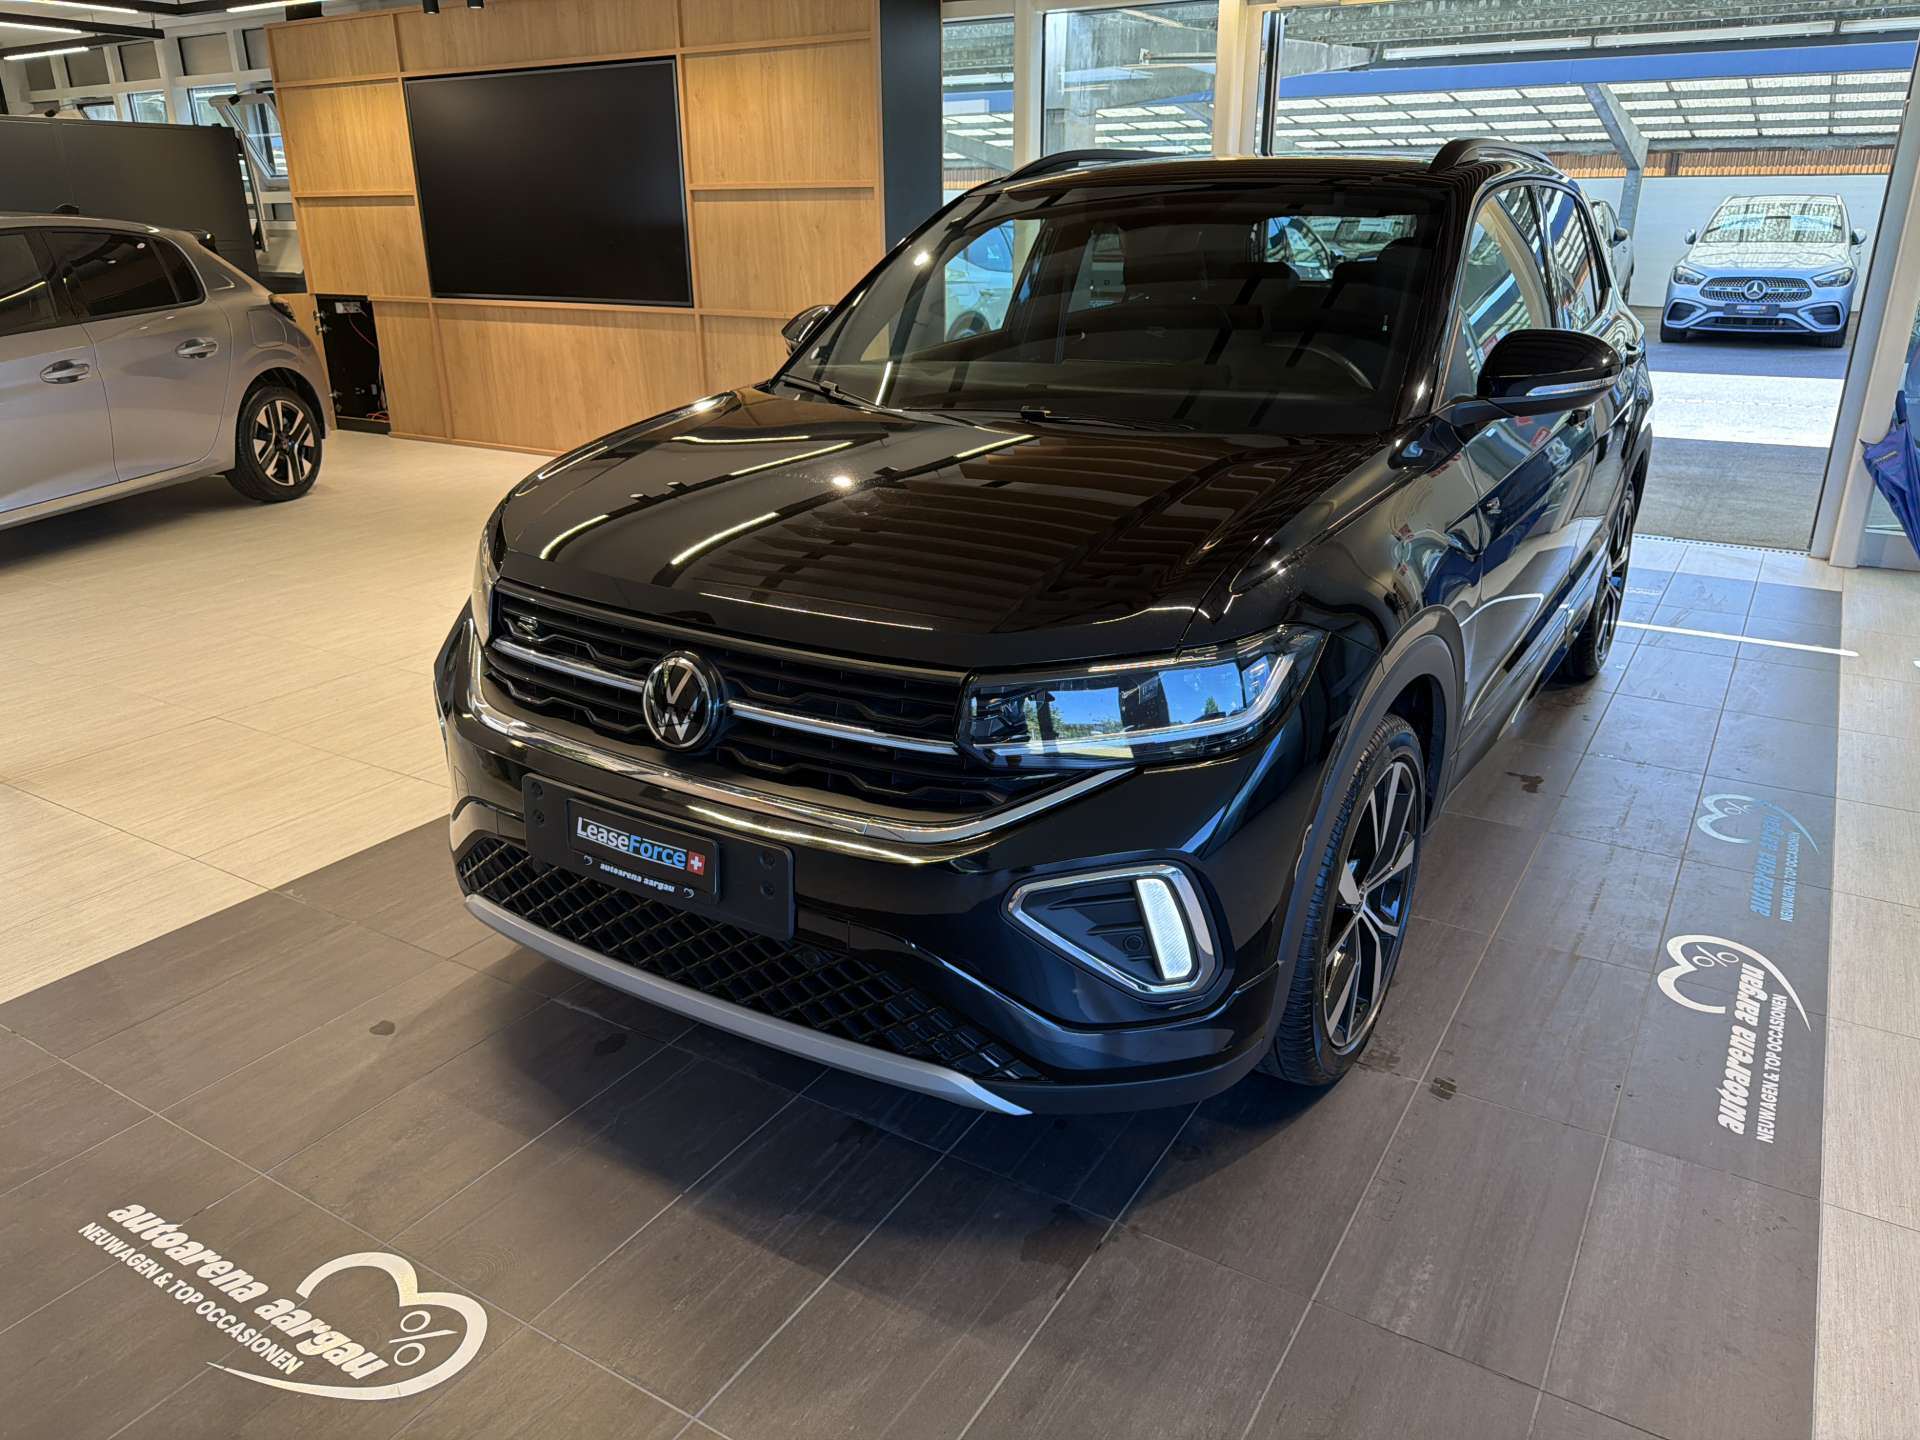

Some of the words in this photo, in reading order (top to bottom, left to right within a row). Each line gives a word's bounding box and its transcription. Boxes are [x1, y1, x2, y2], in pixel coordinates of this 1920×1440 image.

[577, 816, 687, 870] LeaseForce
[600, 862, 642, 882] autoarena
[643, 877, 675, 893] aargau
[1734, 963, 1767, 1026] aargau
[1767, 994, 1787, 1053] OCCASIONEN
[1716, 1025, 1756, 1135] autoarena
[1763, 1068, 1780, 1082] &
[1765, 1048, 1782, 1076] TOP
[1756, 1080, 1779, 1143] NEUWAGEN
[78, 1222, 164, 1280] NEUWAGEN
[153, 1272, 174, 1289] &
[166, 1279, 204, 1305] TOP
[195, 1300, 304, 1375] OCCASIONEN
[107, 1204, 269, 1304] autoarena
[254, 1299, 389, 1380] aargau
